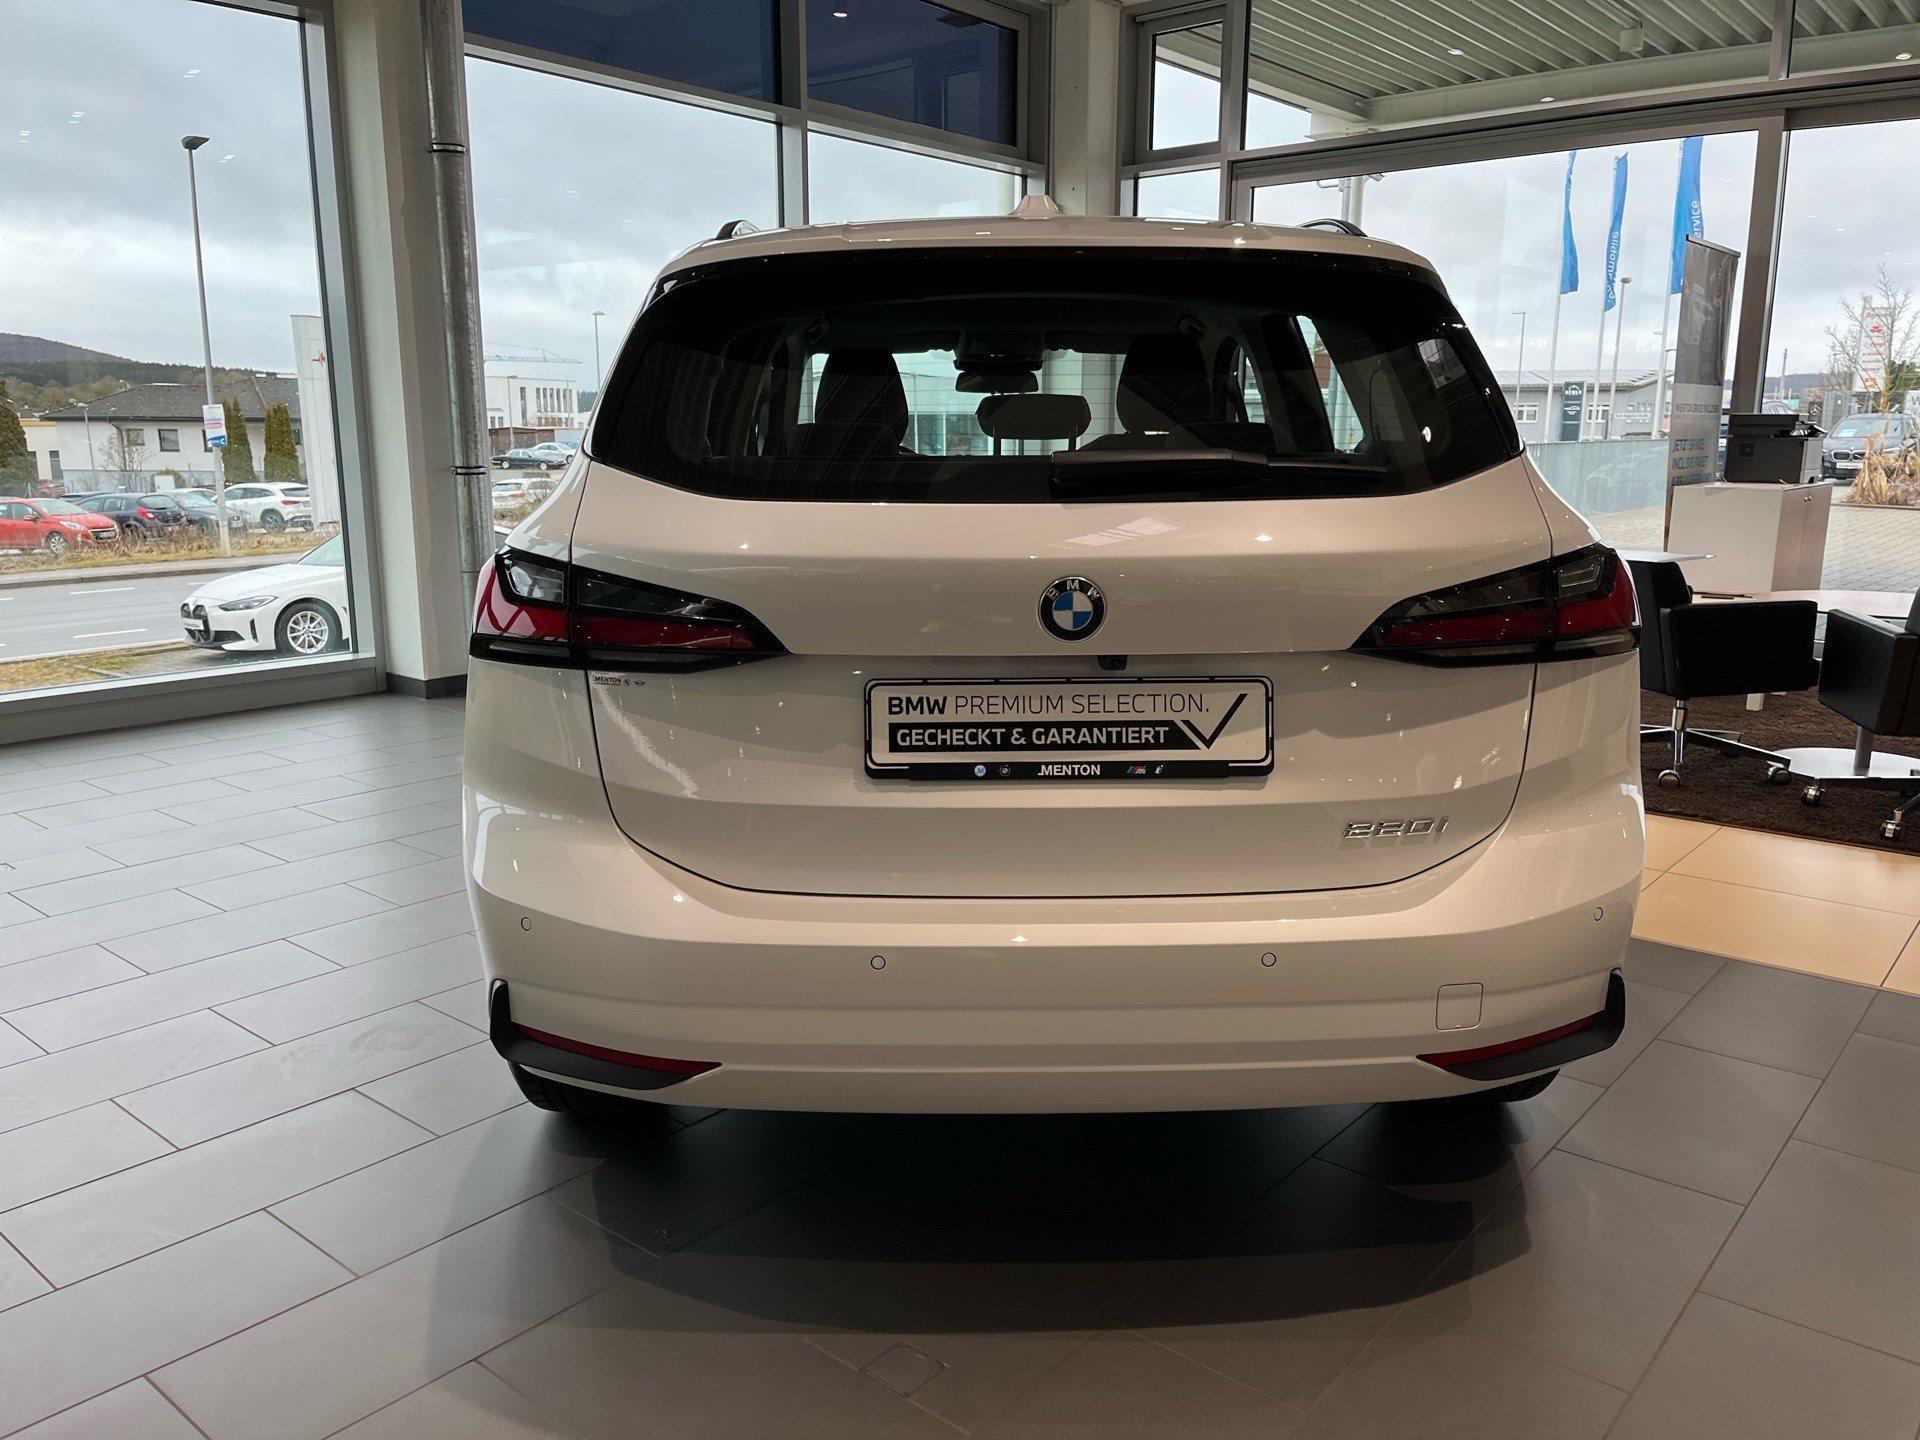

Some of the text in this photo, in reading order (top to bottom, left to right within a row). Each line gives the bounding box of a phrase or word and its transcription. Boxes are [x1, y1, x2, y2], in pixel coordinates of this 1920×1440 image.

[1690, 200, 1702, 239] ervice
[1047, 579, 1101, 601] BMW
[888, 693, 1209, 715] BMW PREMIUM SELECTION.
[897, 727, 1169, 746] GECHECKT & GARANTIERT
[1038, 764, 1101, 776] MENTON
